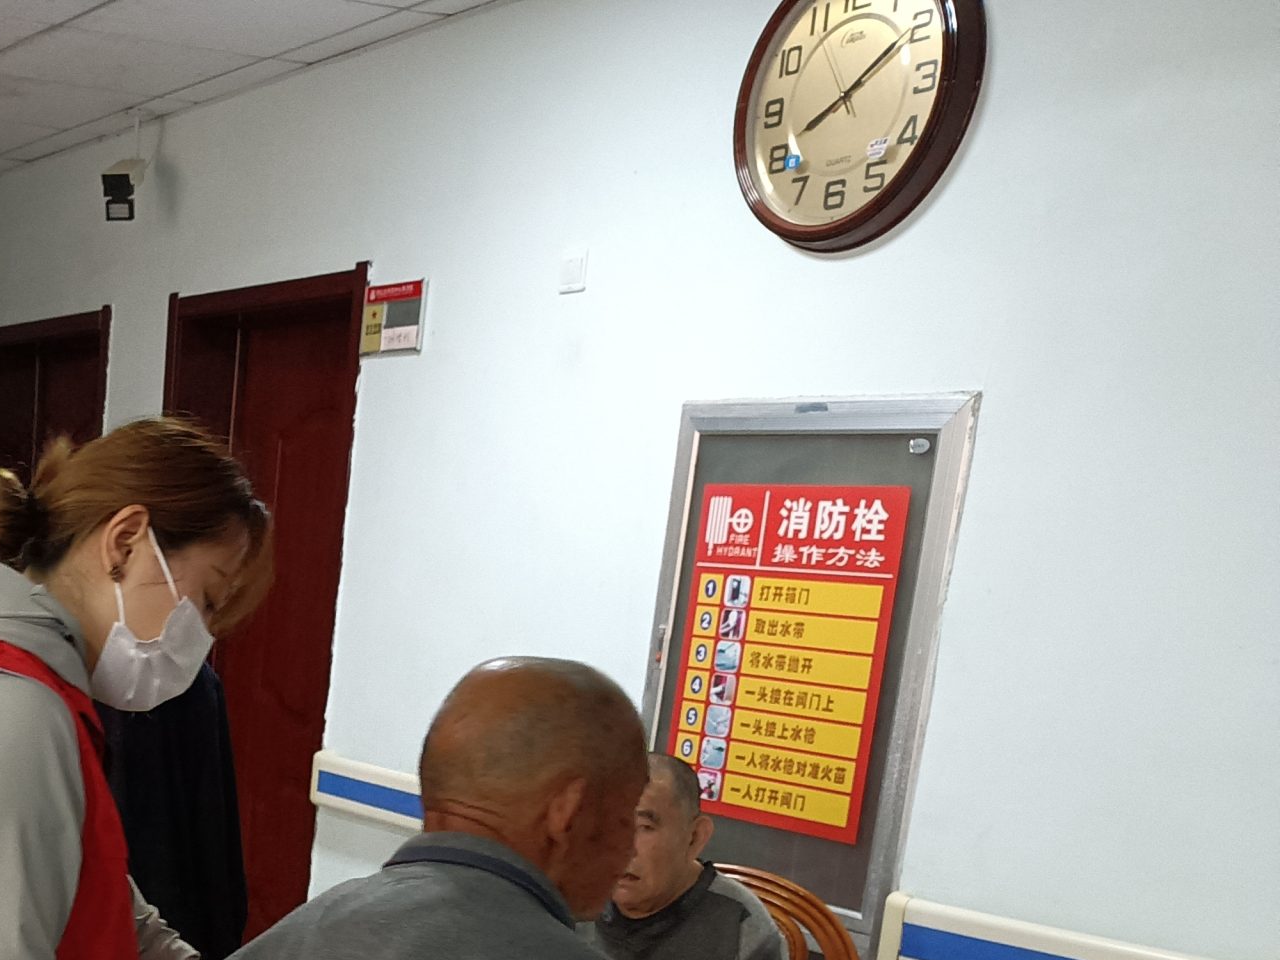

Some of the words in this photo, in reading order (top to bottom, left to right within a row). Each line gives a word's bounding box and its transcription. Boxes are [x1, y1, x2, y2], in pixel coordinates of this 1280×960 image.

[810, 2, 830, 36] 11
[909, 9, 934, 44] 2
[778, 45, 803, 79] 10
[913, 58, 939, 95] 3
[764, 97, 785, 129] 9
[896, 114, 919, 146] 4
[769, 143, 789, 175] 8
[791, 175, 810, 206] 7
[863, 159, 888, 193] 5
[823, 179, 847, 211] 6
[777, 497, 889, 541] 消防栓
[728, 533, 751, 545] FIRE
[770, 543, 885, 568] 操作方法
[758, 585, 811, 606] 打开箱门
[753, 617, 806, 640] 取出水带
